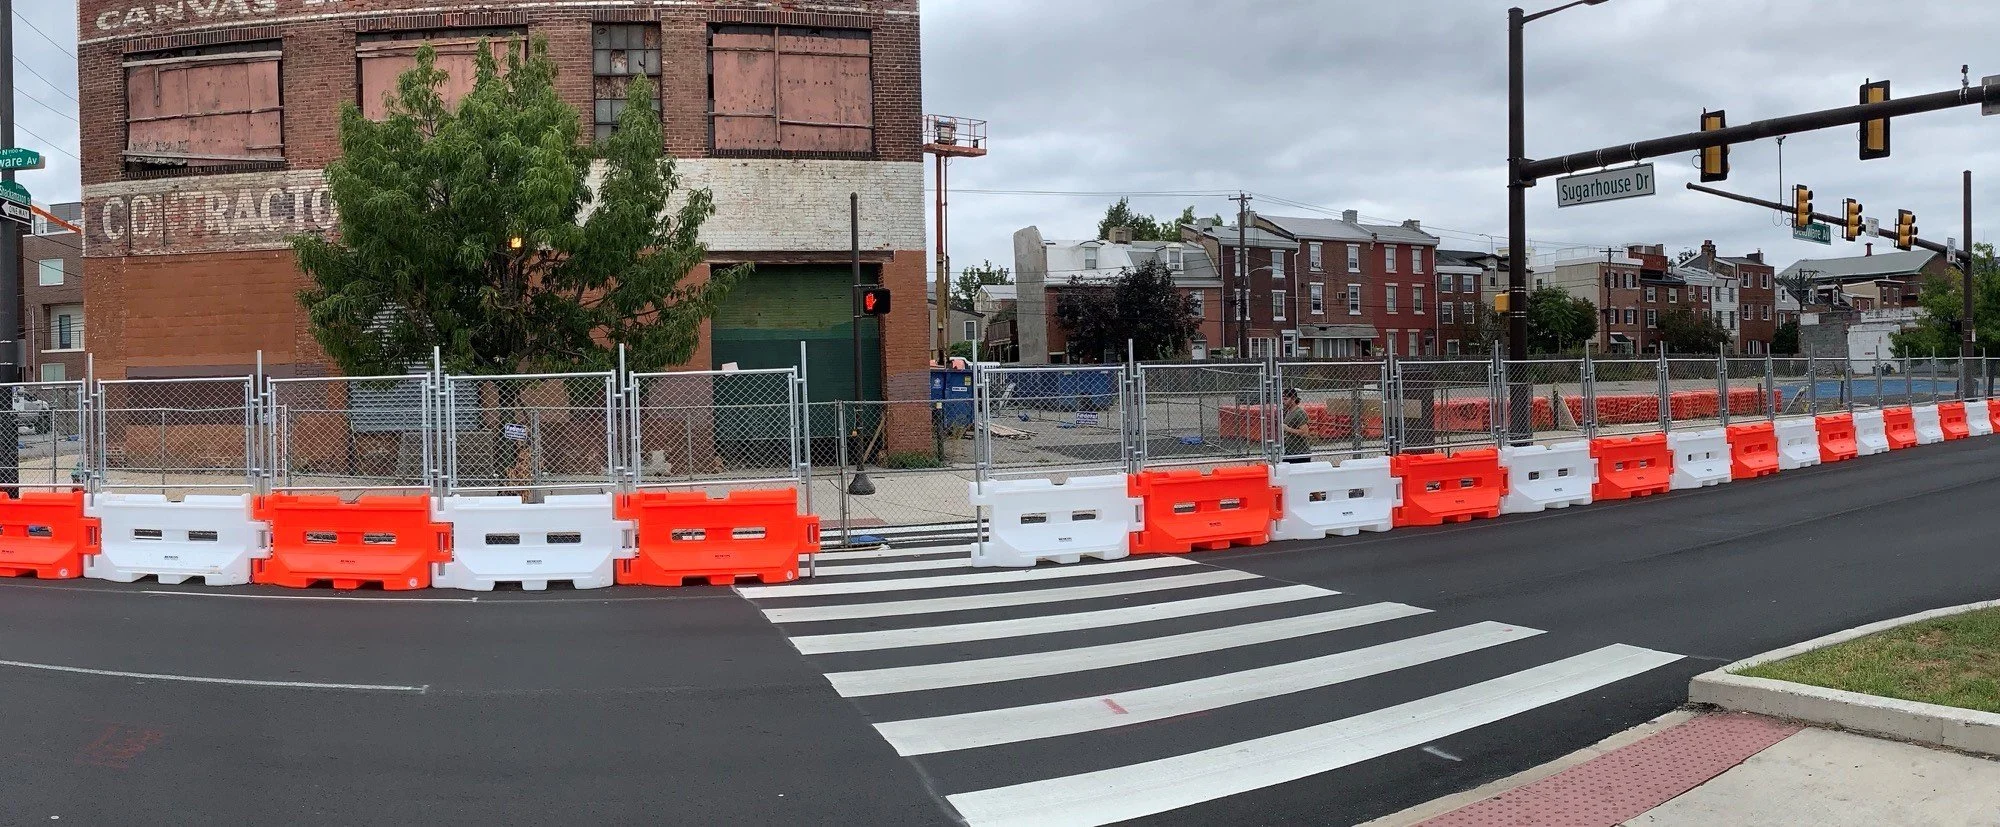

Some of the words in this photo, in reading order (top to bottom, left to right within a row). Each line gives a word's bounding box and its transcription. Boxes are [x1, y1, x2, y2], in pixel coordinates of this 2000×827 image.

[96, 0, 278, 30] CANVAS
[26, 156, 37, 165] Av
[1562, 178, 1630, 201] Sugarhouse
[1636, 173, 1649, 191] Dr
[9, 205, 18, 215] ONE
[18, 208, 28, 218] WAY
